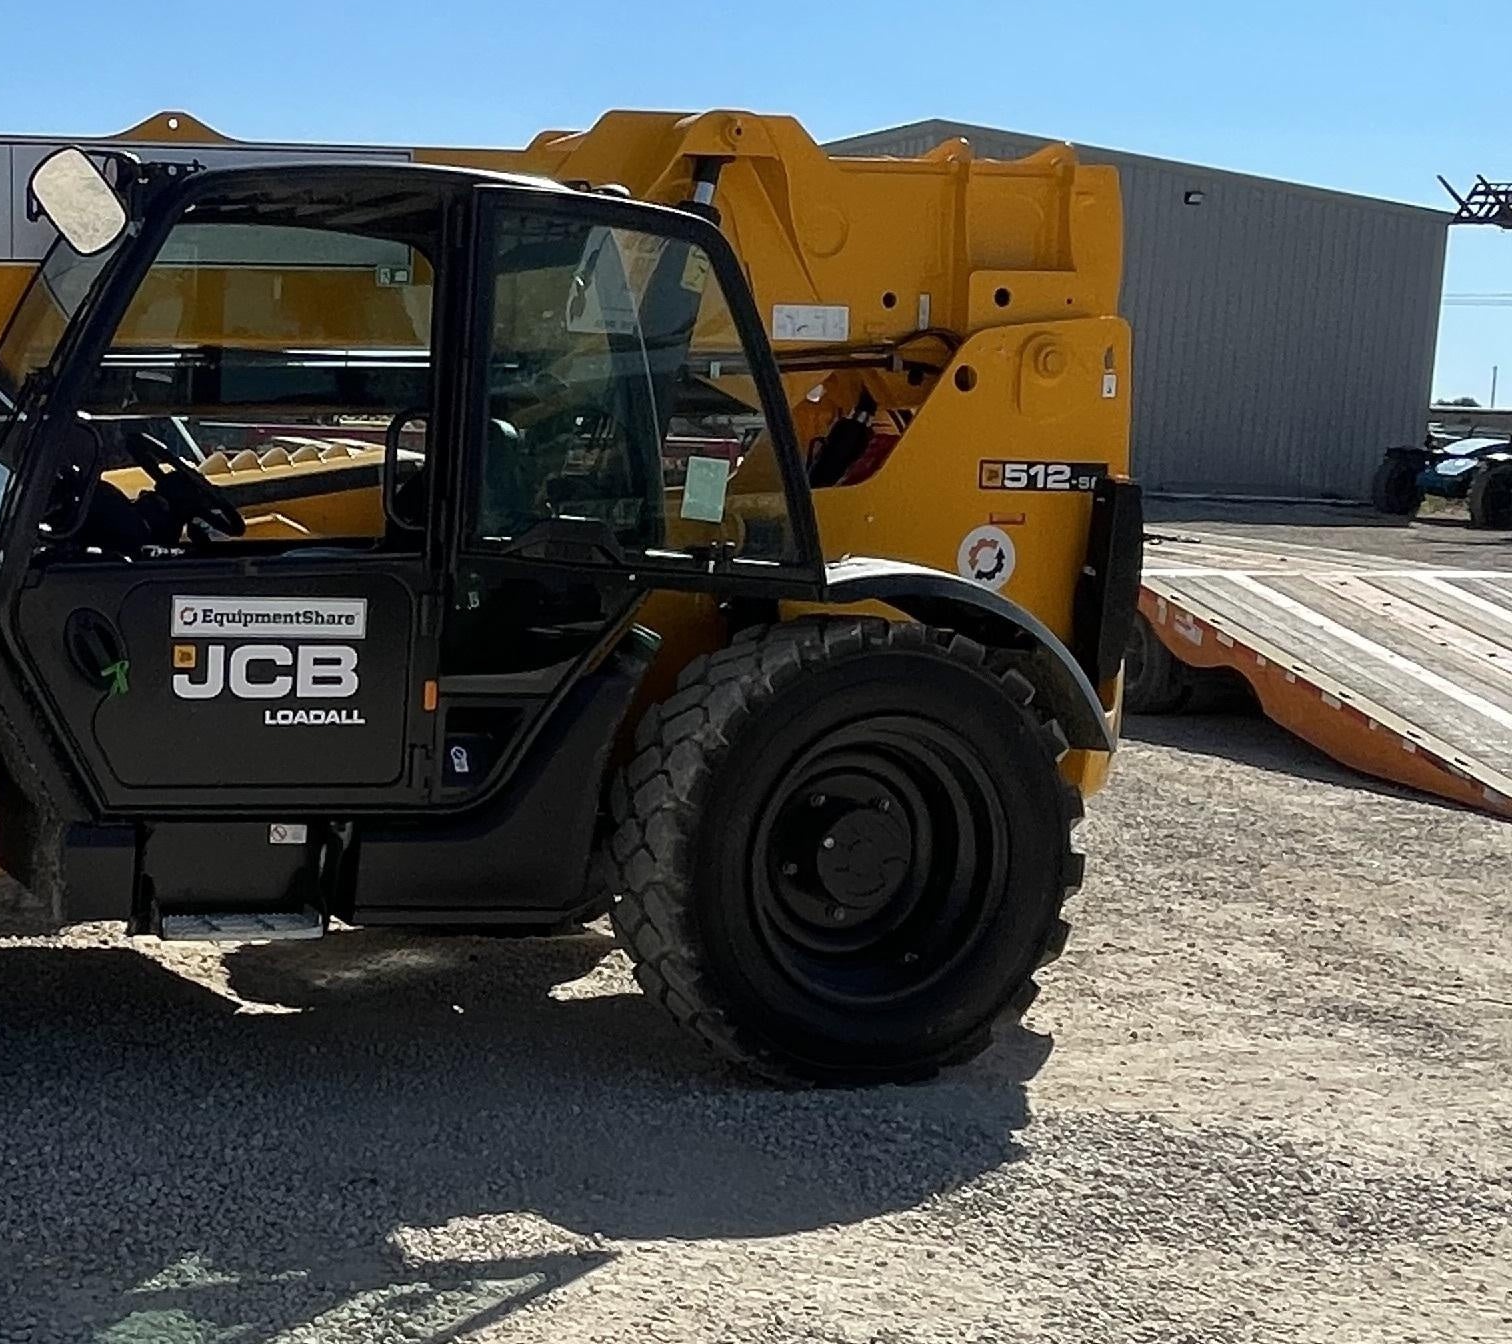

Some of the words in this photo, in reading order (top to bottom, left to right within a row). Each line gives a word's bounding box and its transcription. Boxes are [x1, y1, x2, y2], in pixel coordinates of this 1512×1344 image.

[200, 608, 356, 628] EquipmentShare
[172, 643, 359, 699] JCB
[263, 709, 366, 725] LOADALL
